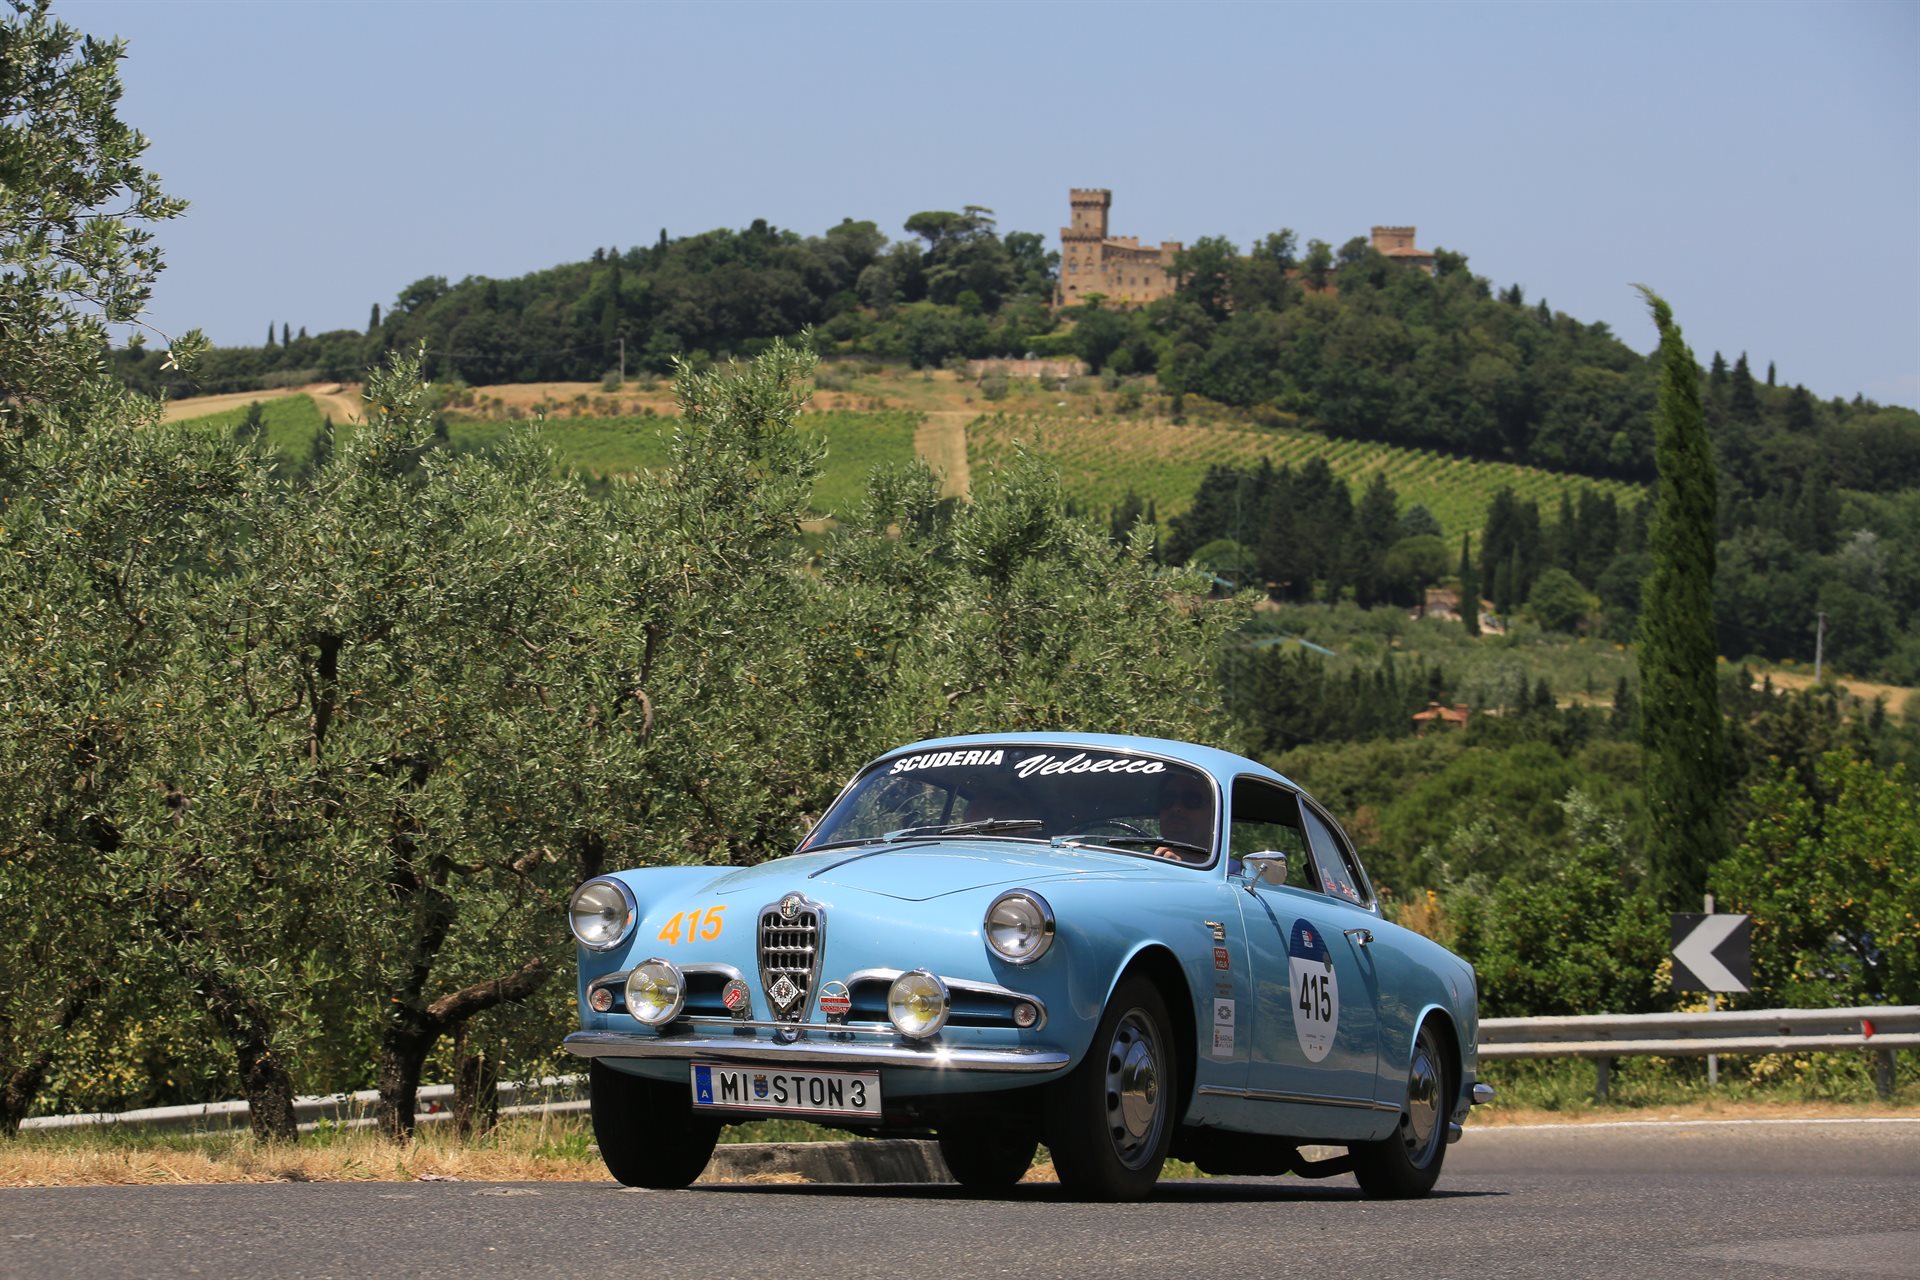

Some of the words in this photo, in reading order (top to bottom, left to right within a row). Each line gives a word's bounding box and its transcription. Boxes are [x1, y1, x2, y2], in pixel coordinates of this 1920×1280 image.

[890, 750, 1004, 775] SCUDERIA
[1014, 753, 1166, 778] Velsecco
[658, 905, 727, 945] 415
[1300, 973, 1331, 1022] 415
[701, 1090, 709, 1099] A
